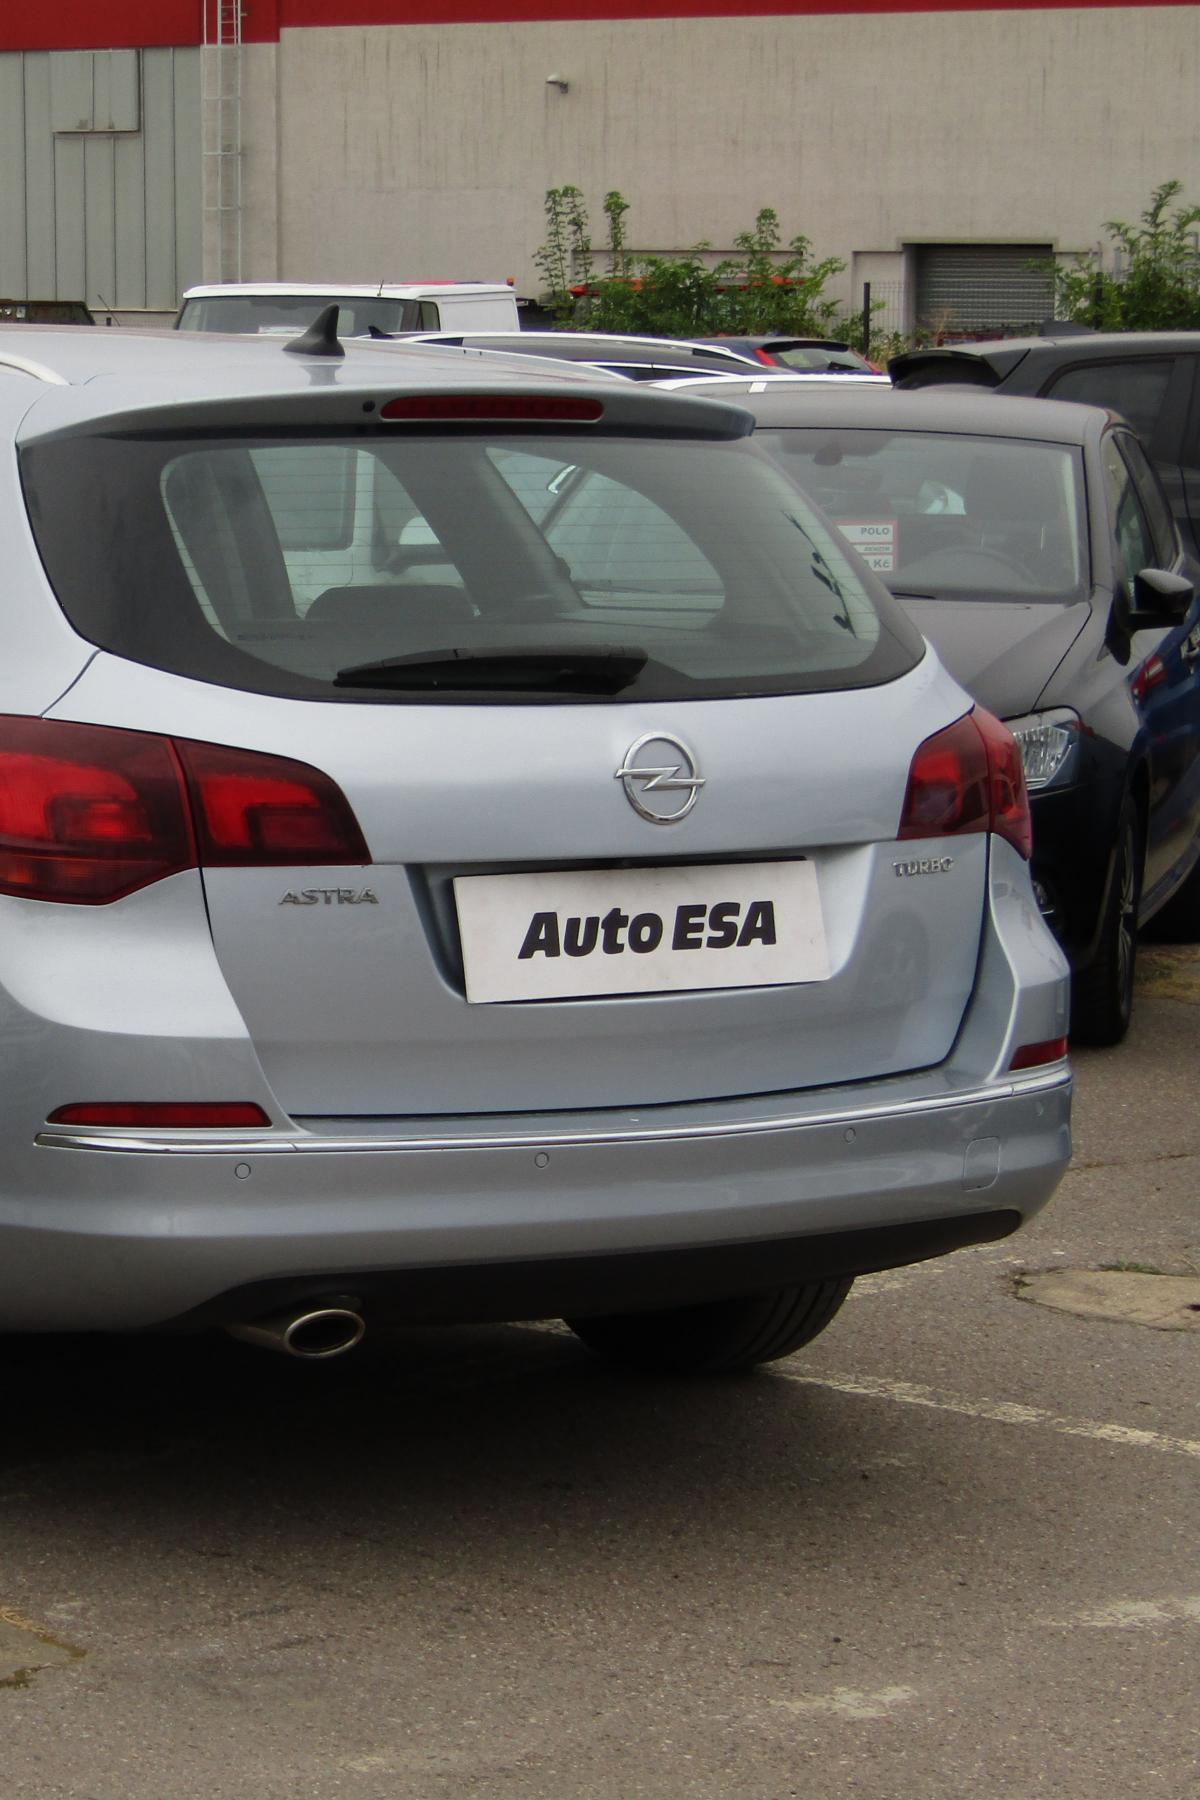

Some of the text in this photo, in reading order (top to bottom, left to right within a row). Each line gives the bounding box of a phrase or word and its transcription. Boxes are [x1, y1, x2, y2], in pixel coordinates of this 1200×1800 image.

[860, 527, 890, 536] POLO
[873, 559, 890, 569] Kč
[892, 857, 954, 877] TURBO
[278, 887, 379, 905] ASTRA
[518, 901, 776, 959] Auto ESA
